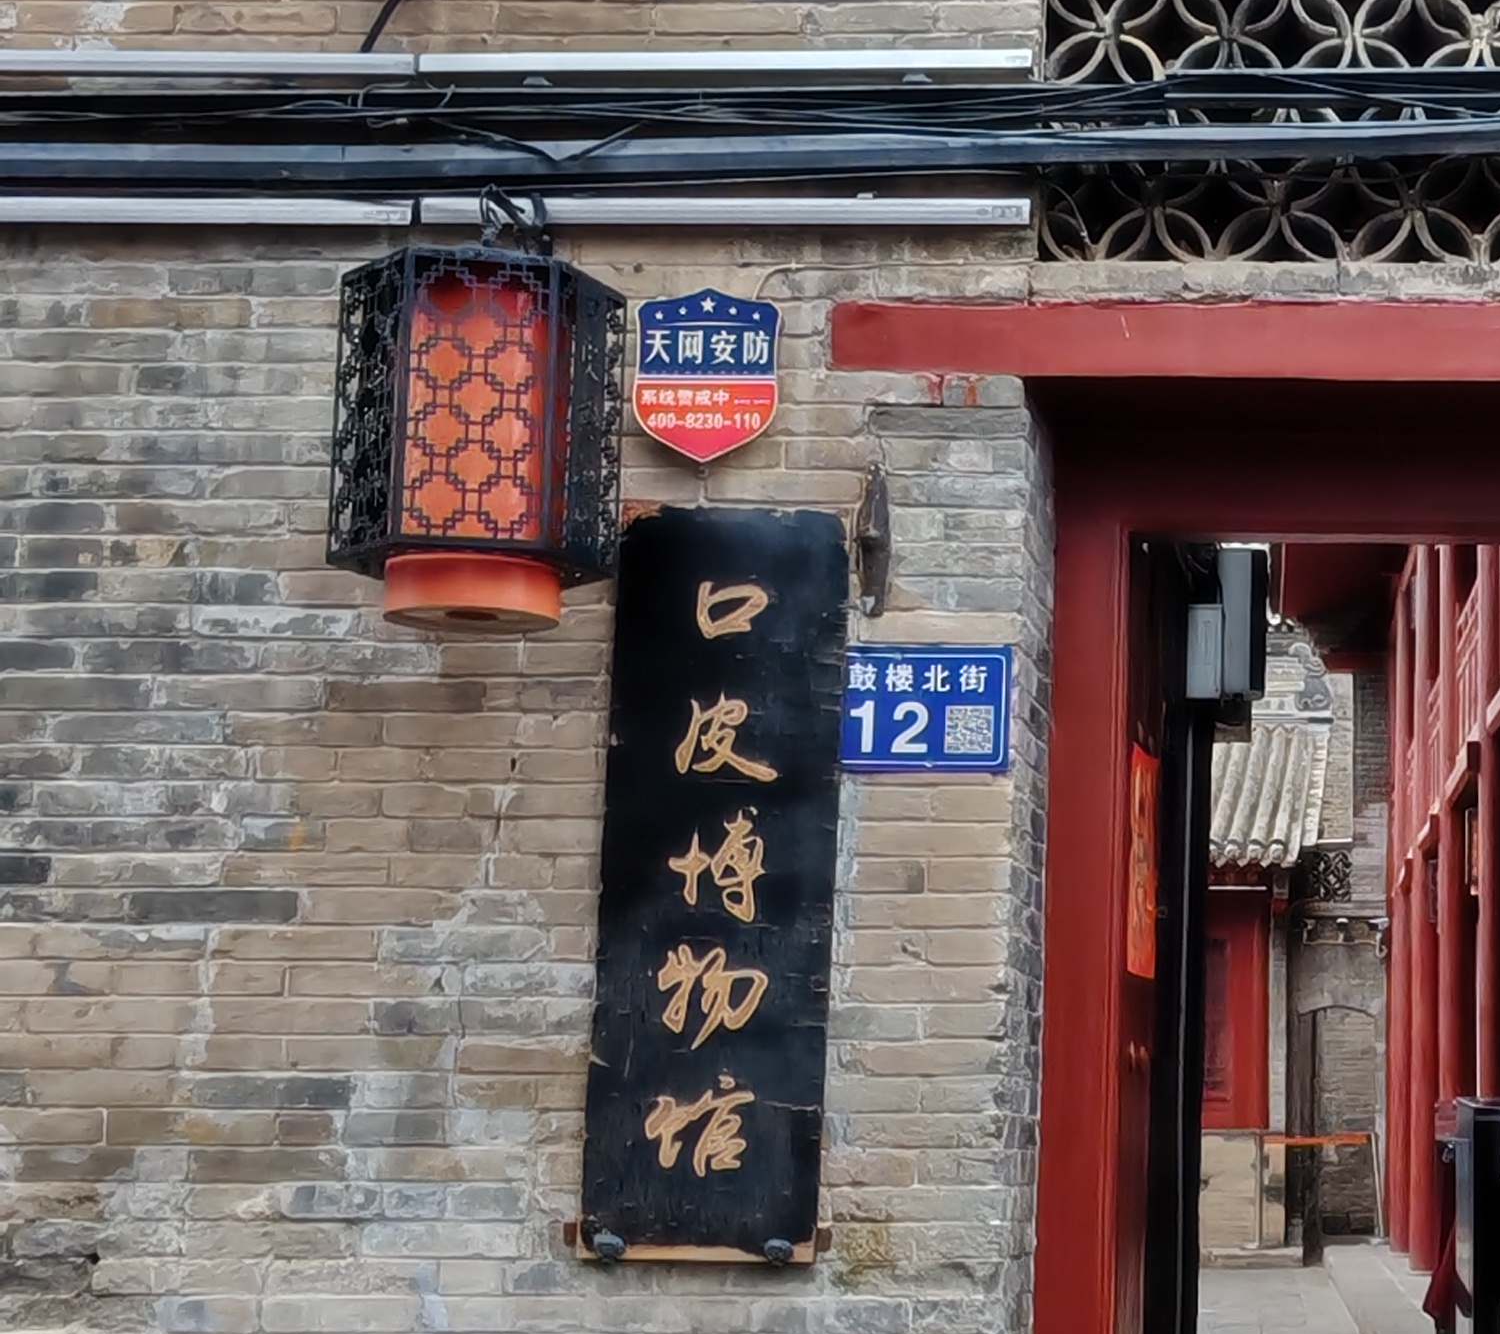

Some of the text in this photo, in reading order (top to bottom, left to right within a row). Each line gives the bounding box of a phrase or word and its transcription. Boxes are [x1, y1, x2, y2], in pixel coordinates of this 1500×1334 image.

[644, 330, 770, 365] 天网安防
[646, 412, 761, 430] 400-8230-110
[848, 662, 988, 693] 鼓楼北街
[850, 700, 929, 753] 12
[645, 580, 779, 1178] 口皮博物馆
